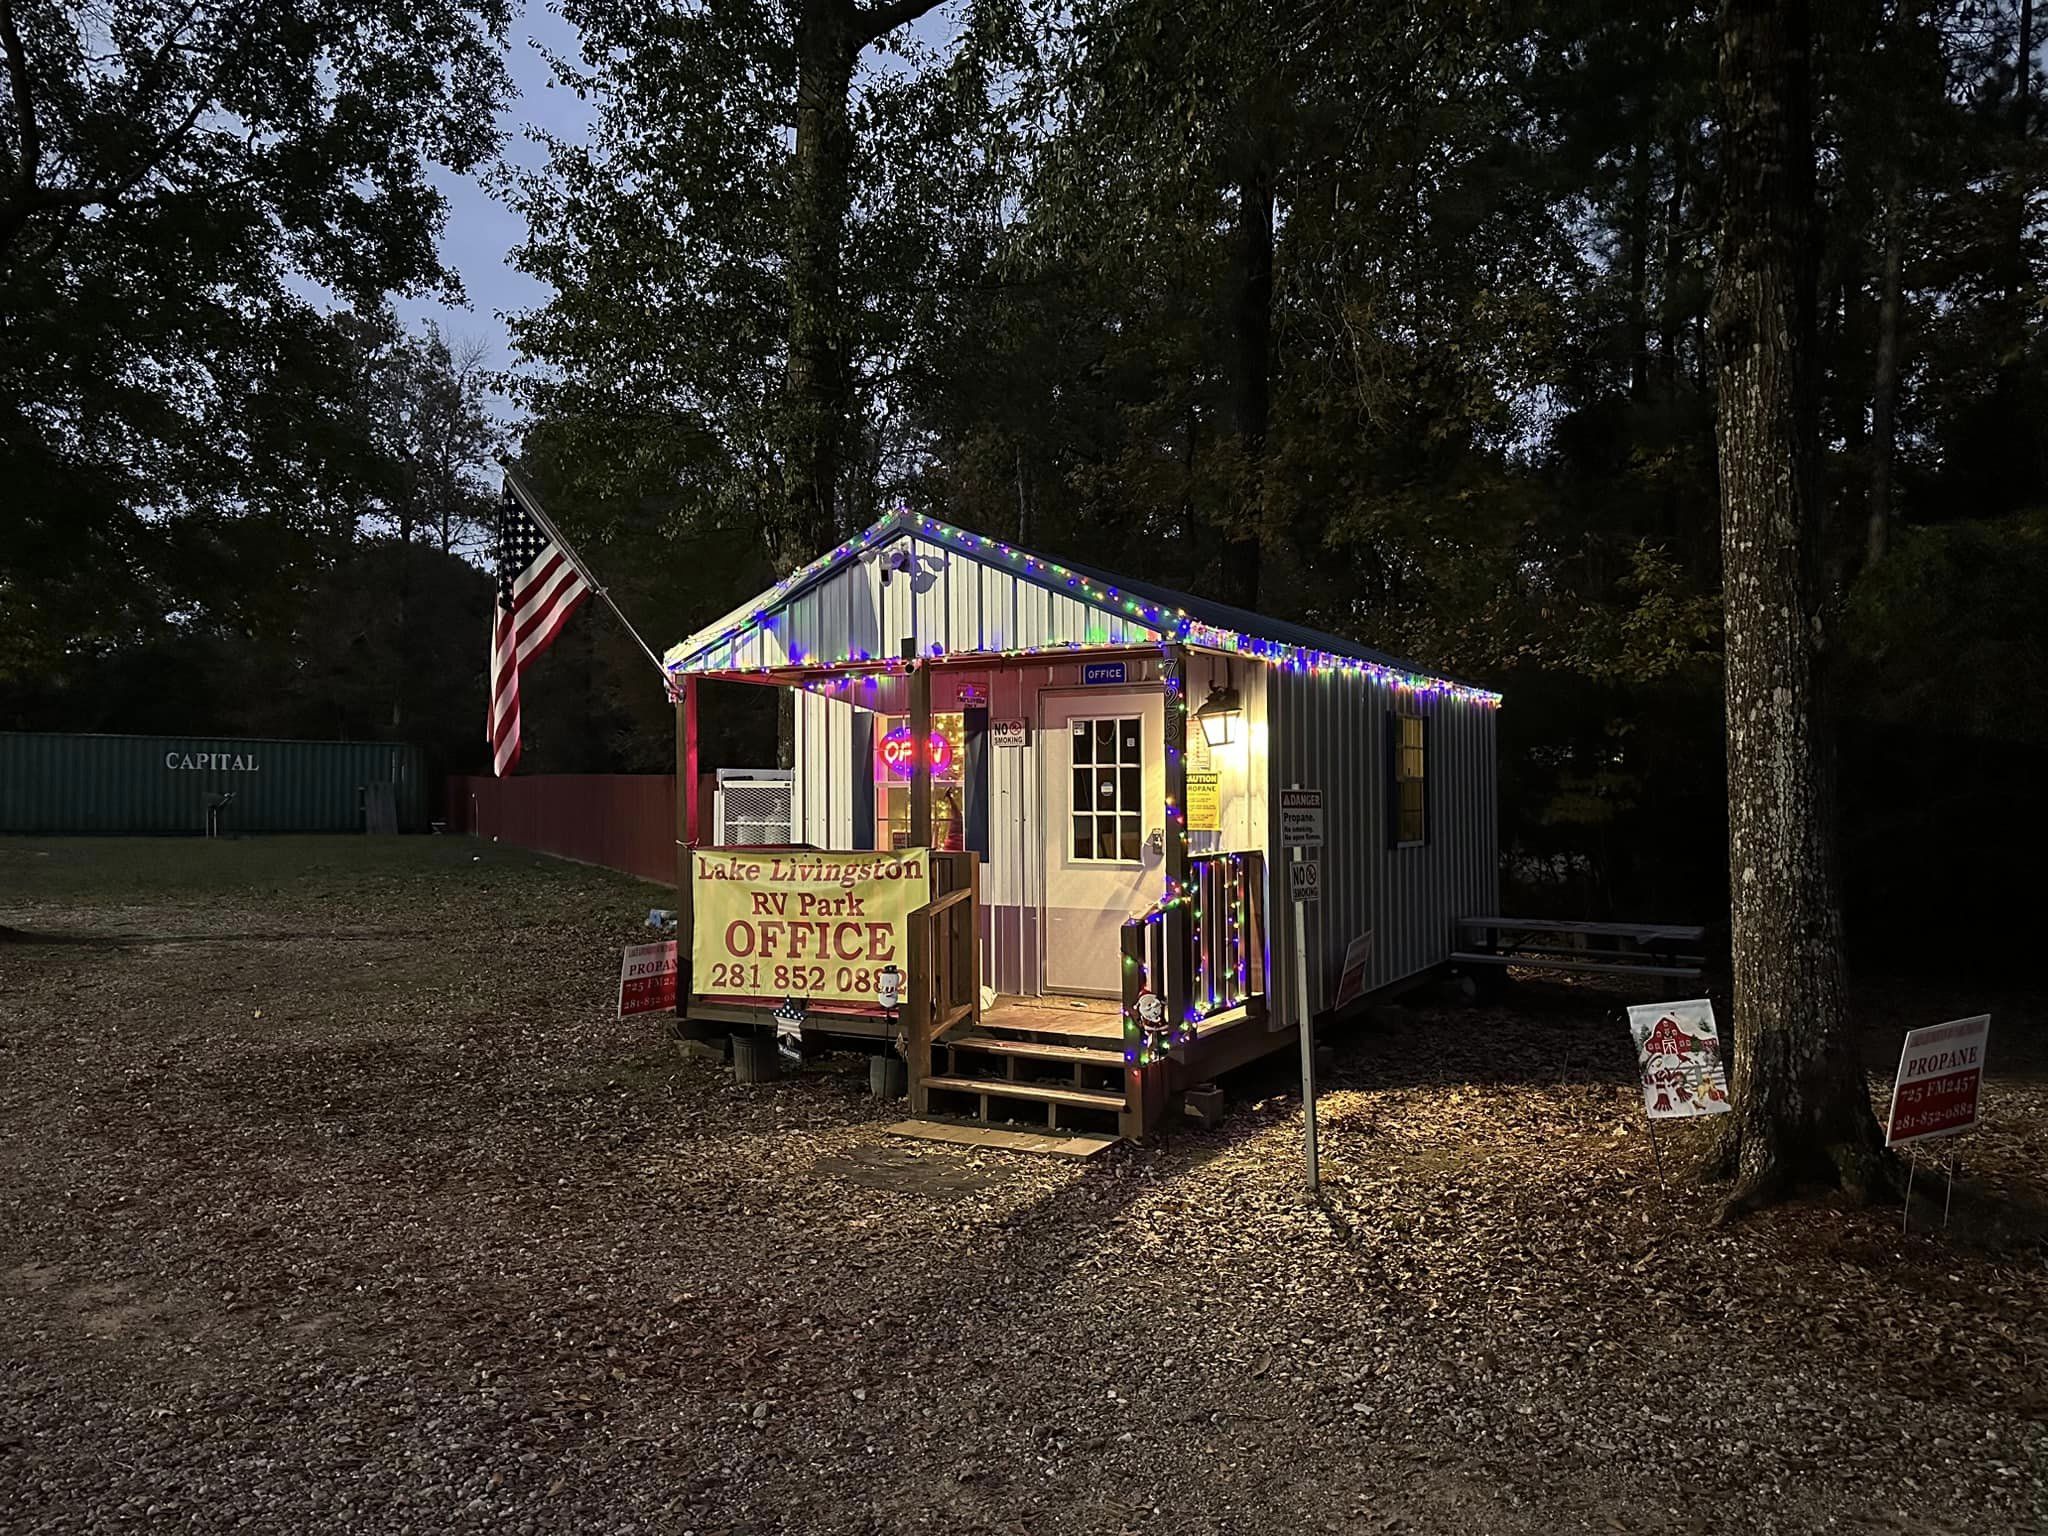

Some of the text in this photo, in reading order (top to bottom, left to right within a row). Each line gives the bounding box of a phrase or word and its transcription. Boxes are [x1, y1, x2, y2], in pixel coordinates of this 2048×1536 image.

[1087, 668, 1122, 680] OFFICE
[994, 722, 1008, 736] NO
[994, 736, 1023, 745] SMOKING
[165, 752, 260, 772] CAPITAL
[884, 741, 944, 764] OPN
[1186, 774, 1217, 784] AUTION
[1290, 794, 1320, 806] DANGER
[1283, 812, 1316, 825] Propane.
[697, 856, 923, 889] Lake Livingston
[1293, 866, 1305, 886] NO
[1293, 886, 1319, 898] SMOKING
[750, 890, 866, 917] RV Park
[724, 919, 896, 962] OFFICE
[629, 958, 677, 977] PROPAN
[711, 962, 761, 988] 281
[773, 964, 826, 991] 852
[1906, 1046, 1979, 1078] PROPANE
[1900, 1074, 1977, 1104] 725 FM2457
[1894, 1102, 1974, 1131] 281-852-0882
